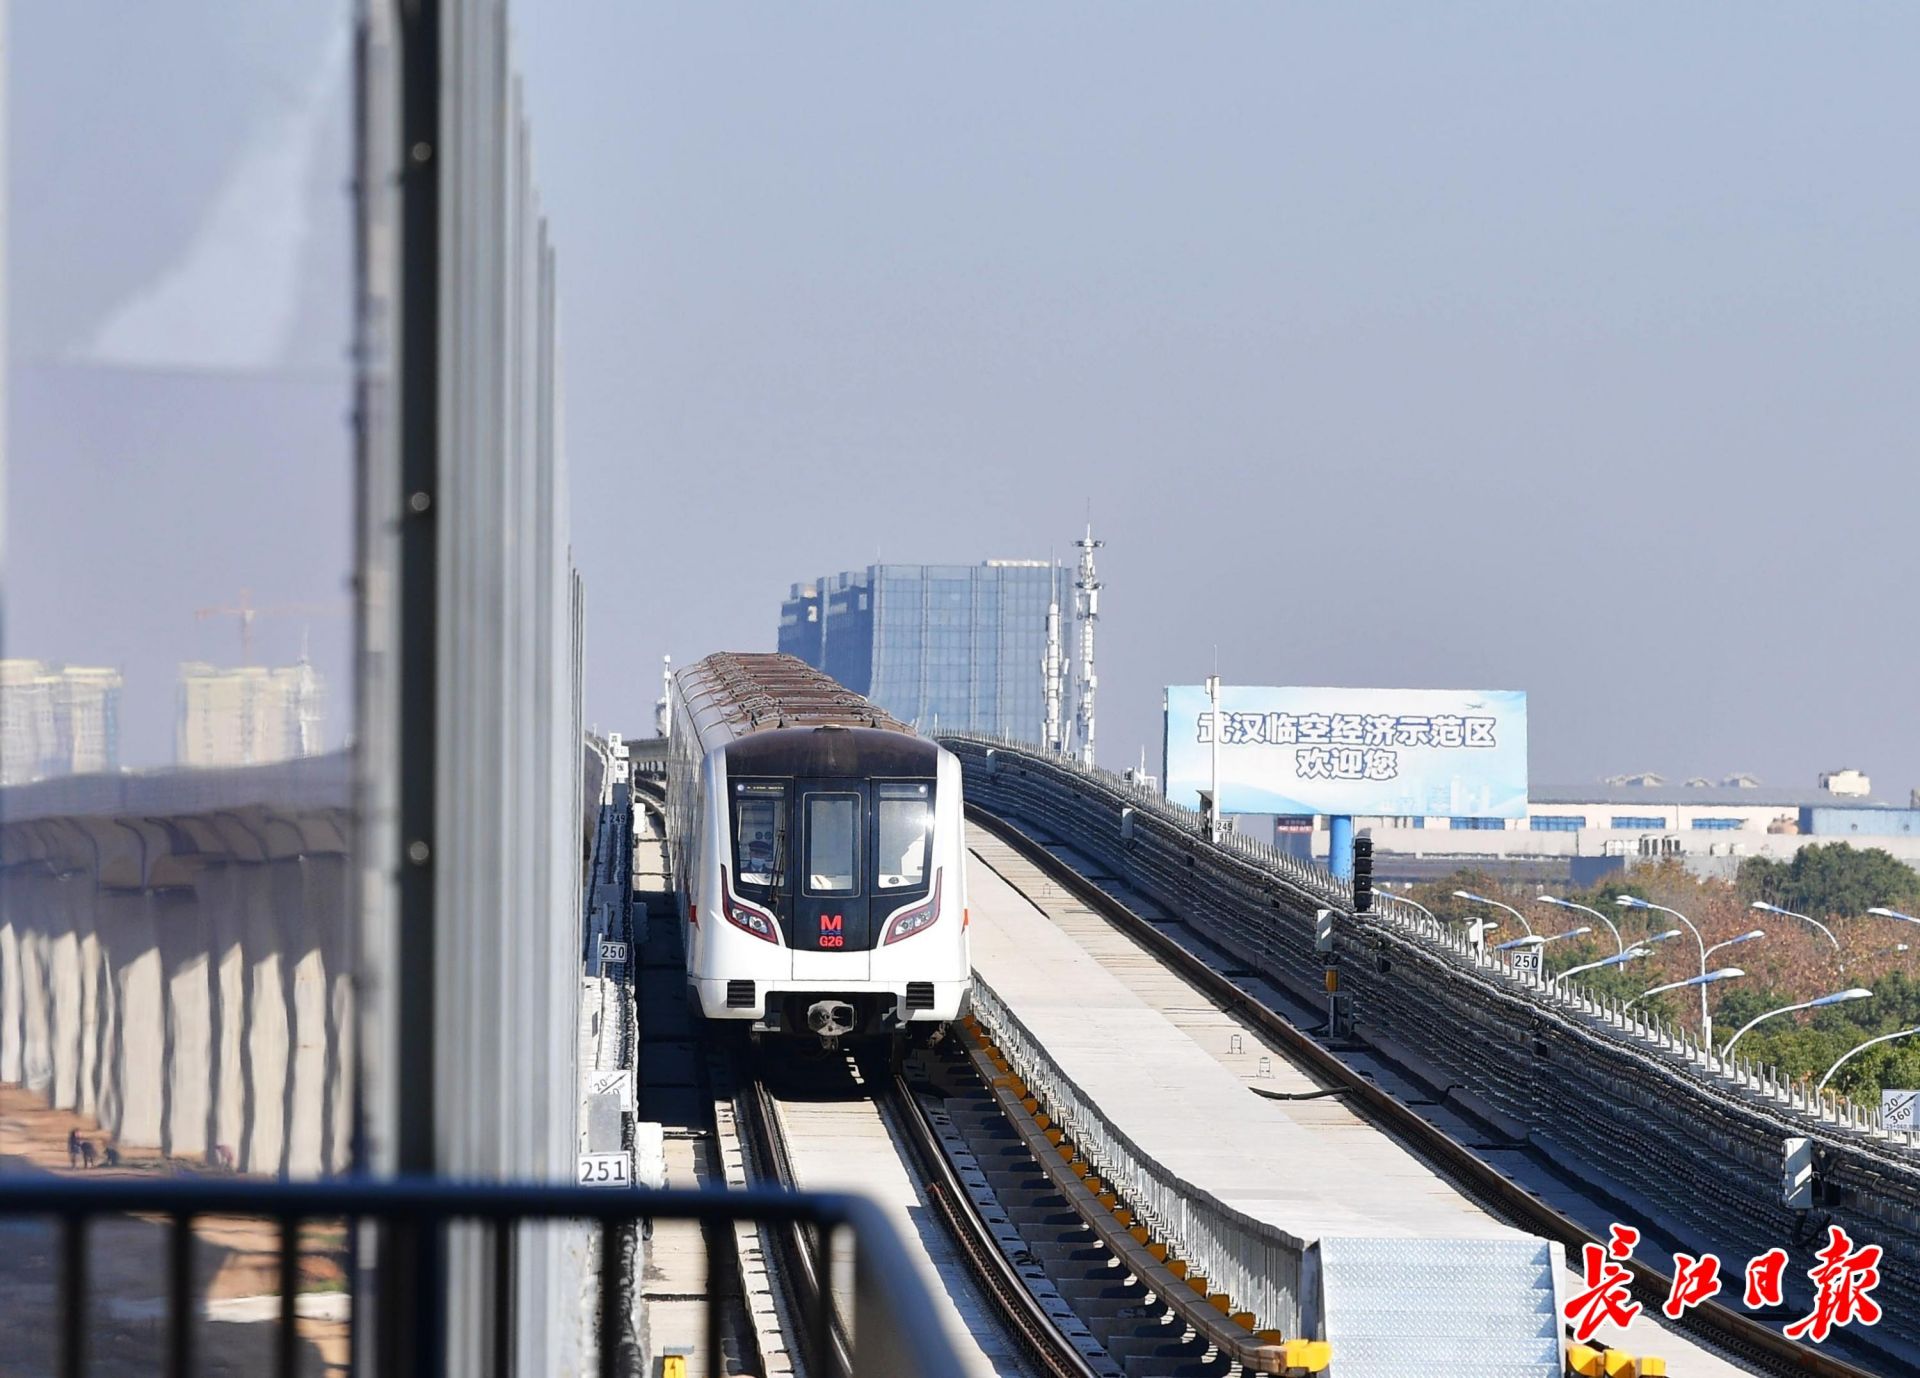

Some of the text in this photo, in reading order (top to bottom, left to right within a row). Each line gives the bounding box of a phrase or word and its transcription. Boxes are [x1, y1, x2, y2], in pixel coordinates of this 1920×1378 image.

[1197, 712, 1496, 747] 武汉临空经济示范区
[1296, 748, 1397, 780] 欢迎您
[1217, 822, 1233, 831] 249
[819, 935, 844, 947] G26
[602, 944, 625, 958] 250
[1515, 954, 1538, 968] 250
[581, 1160, 627, 1182] 251
